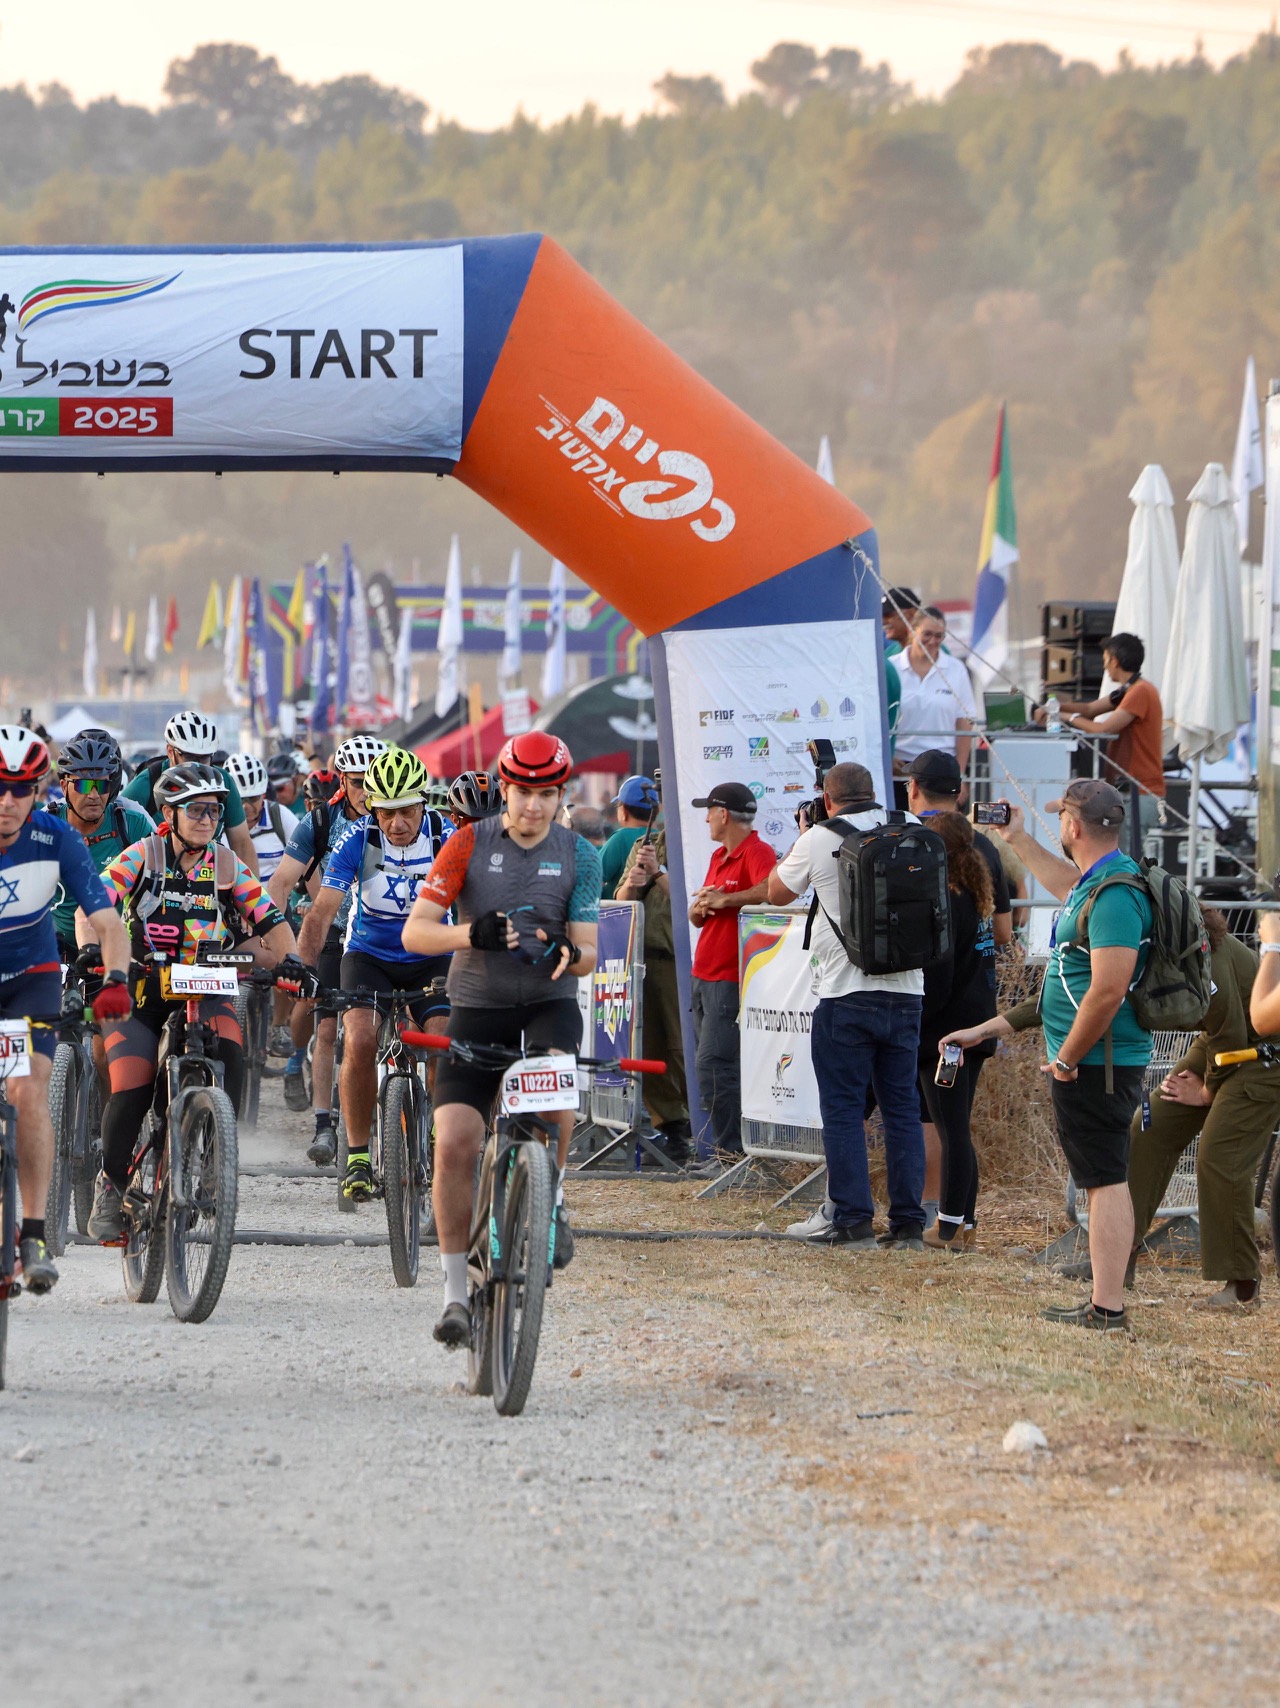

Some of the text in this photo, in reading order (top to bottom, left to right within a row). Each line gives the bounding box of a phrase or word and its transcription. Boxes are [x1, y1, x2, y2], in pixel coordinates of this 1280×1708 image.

[15, 333, 174, 388] בשביל
[239, 328, 438, 380] START
[73, 406, 158, 434] 2025
[535, 416, 627, 493] אקטיב
[575, 396, 736, 542] כפיים
[714, 709, 735, 721] FIDF
[30, 830, 54, 846] ISRAEL
[332, 817, 366, 854] ISRA
[166, 901, 180, 909] Sea
[191, 981, 218, 990] 10076
[523, 1073, 556, 1092] 10222
